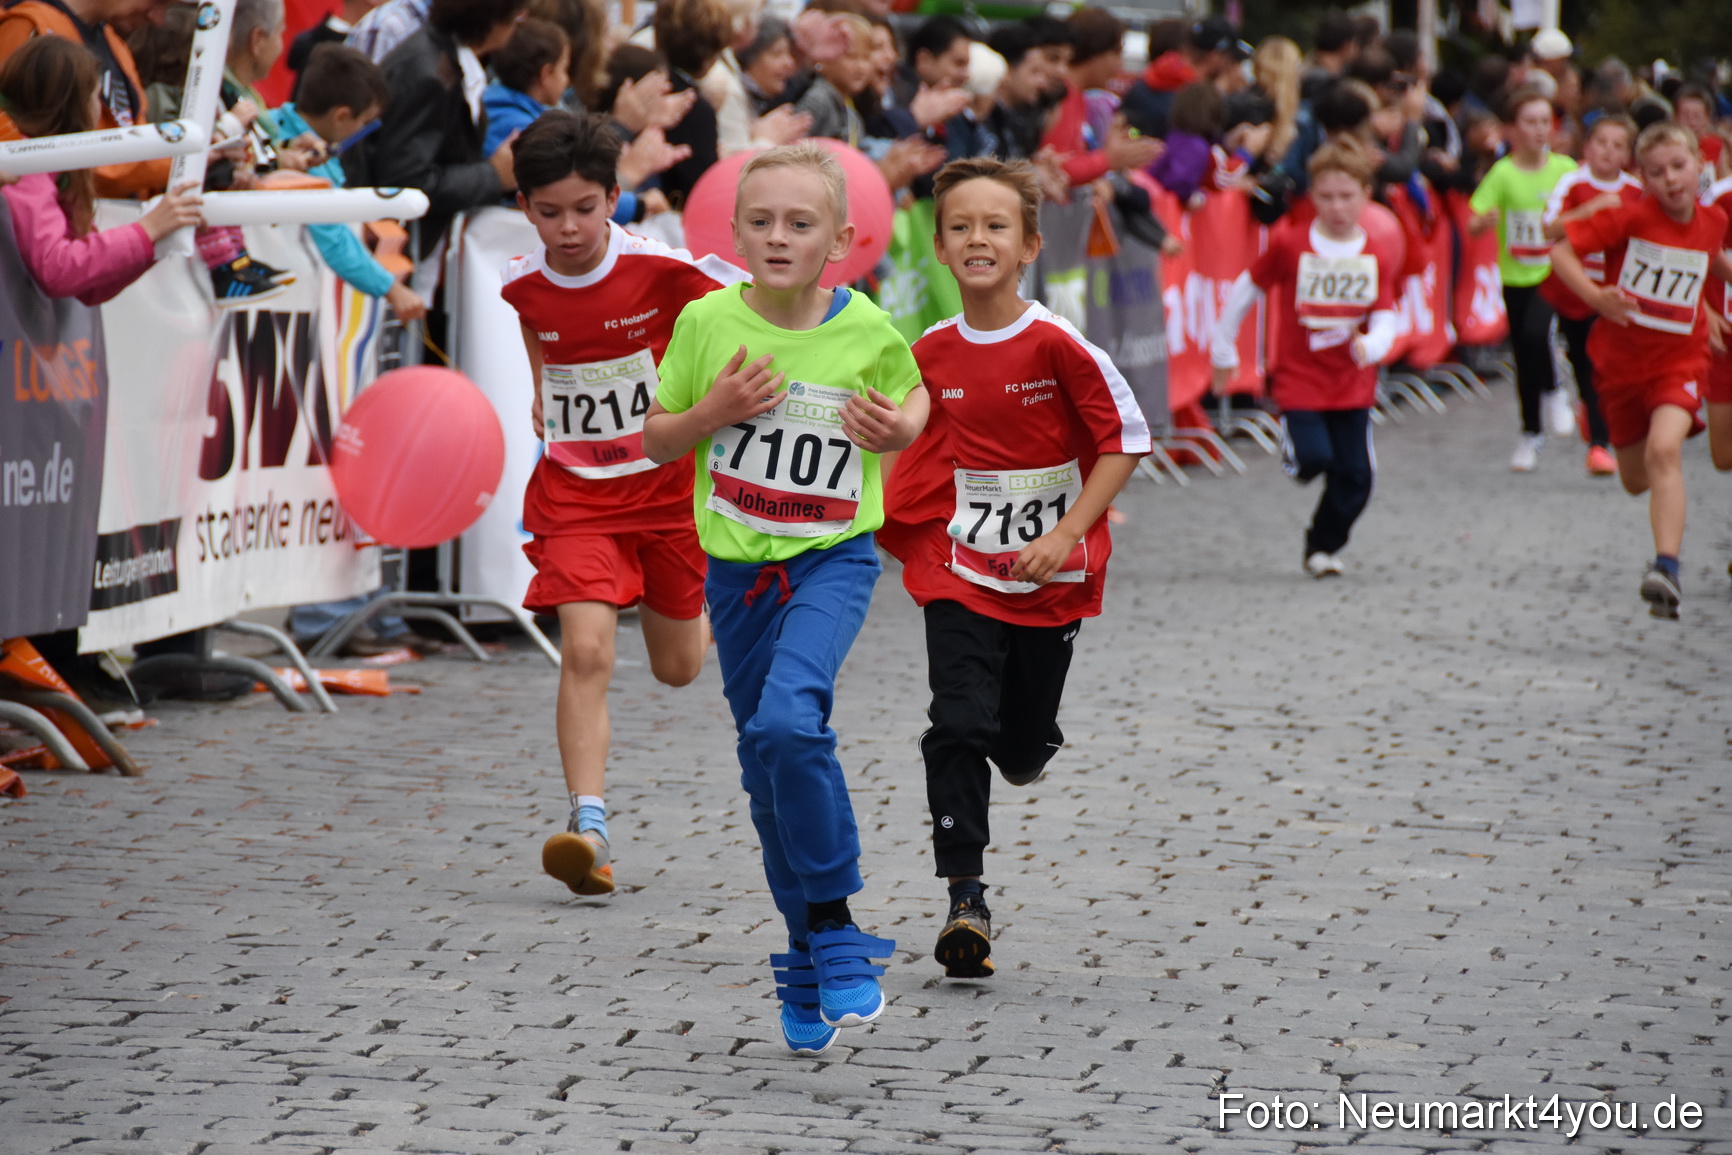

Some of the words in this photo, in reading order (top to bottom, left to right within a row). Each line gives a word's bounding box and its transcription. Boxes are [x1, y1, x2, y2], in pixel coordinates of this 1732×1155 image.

[1306, 271, 1370, 299] 7022
[1631, 258, 1699, 301] 7177
[604, 320, 619, 330] FC
[620, 308, 658, 327] Holzheim
[581, 358, 645, 382] BOCK
[942, 388, 964, 399] JAKO
[1005, 384, 1019, 393] FC
[1021, 392, 1053, 406] Fabian
[552, 381, 651, 434] 7214
[786, 400, 845, 424] BOC
[592, 444, 629, 463] Luis
[713, 461, 719, 470] 6
[729, 422, 852, 490] 7107
[964, 483, 1002, 493] NeuerMarkt
[1009, 467, 1073, 490] BOCK
[733, 486, 826, 520] Johannes
[850, 489, 857, 499] K
[966, 492, 1067, 546] 7131
